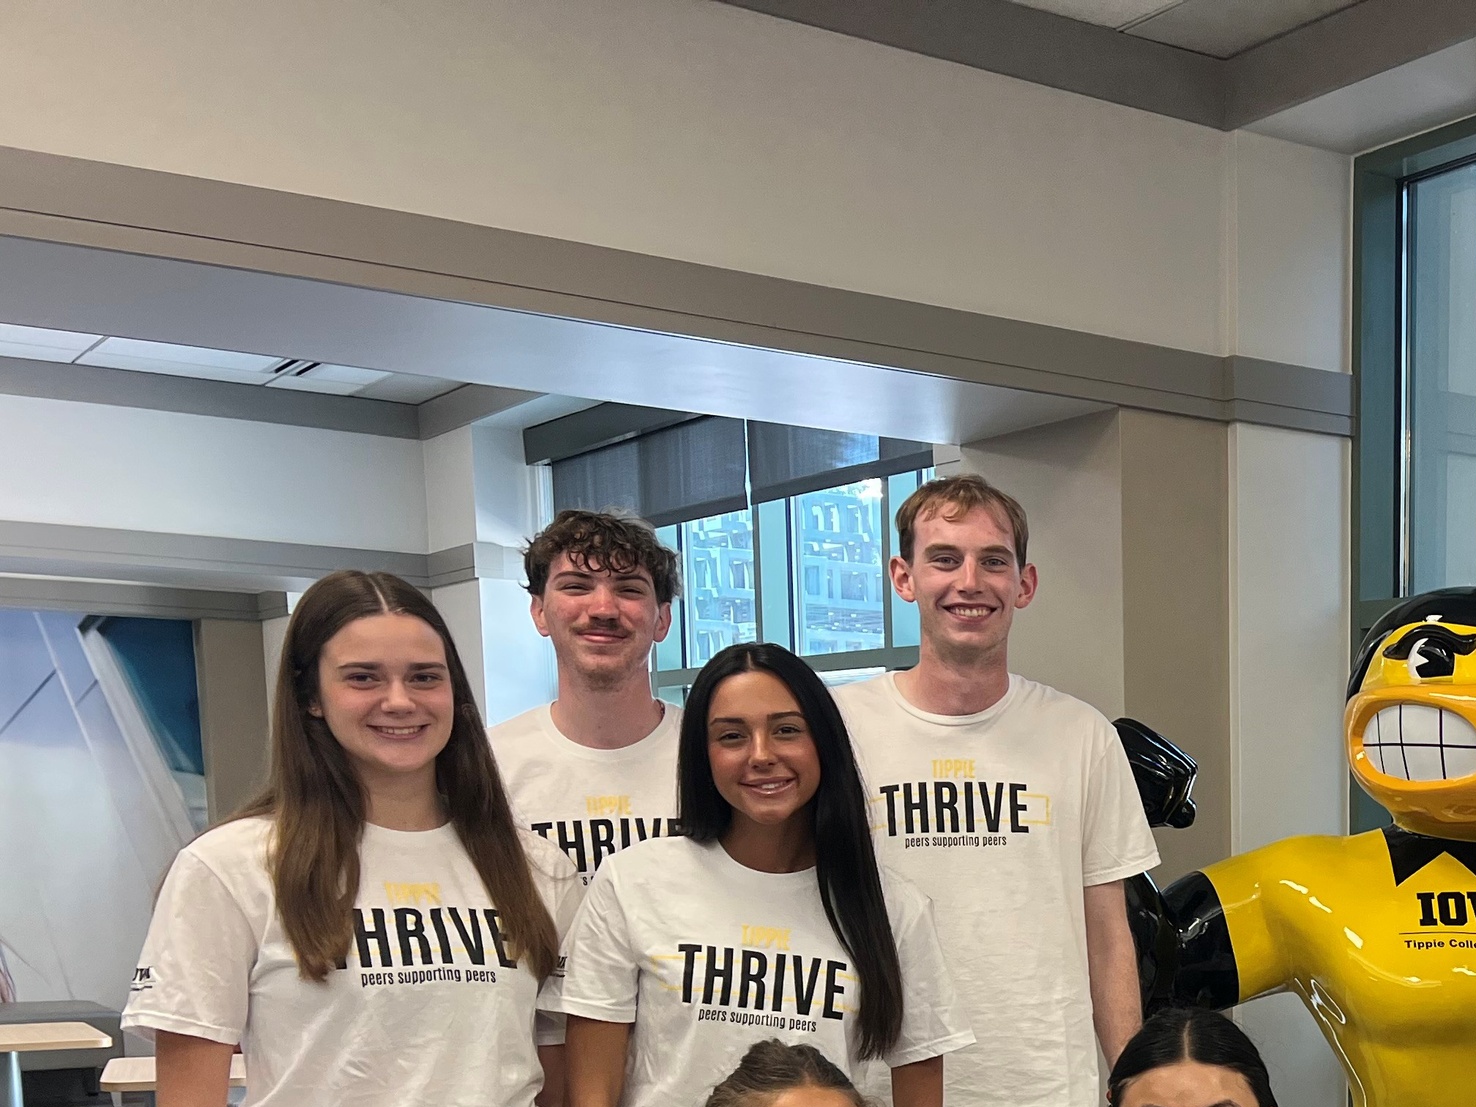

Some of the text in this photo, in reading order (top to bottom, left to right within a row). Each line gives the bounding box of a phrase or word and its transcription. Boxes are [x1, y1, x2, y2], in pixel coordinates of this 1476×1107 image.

[931, 759, 976, 778] TIPPIE
[879, 781, 1029, 836] THRIVE
[531, 818, 682, 872] HRI
[905, 835, 1007, 849] peers supporting peers
[335, 906, 518, 969] HRIVE
[1404, 939, 1445, 950] Tippie
[361, 967, 497, 988] peers supporting peers
[678, 943, 847, 1020] THRIVE
[698, 1008, 817, 1032] peers supporting peers
